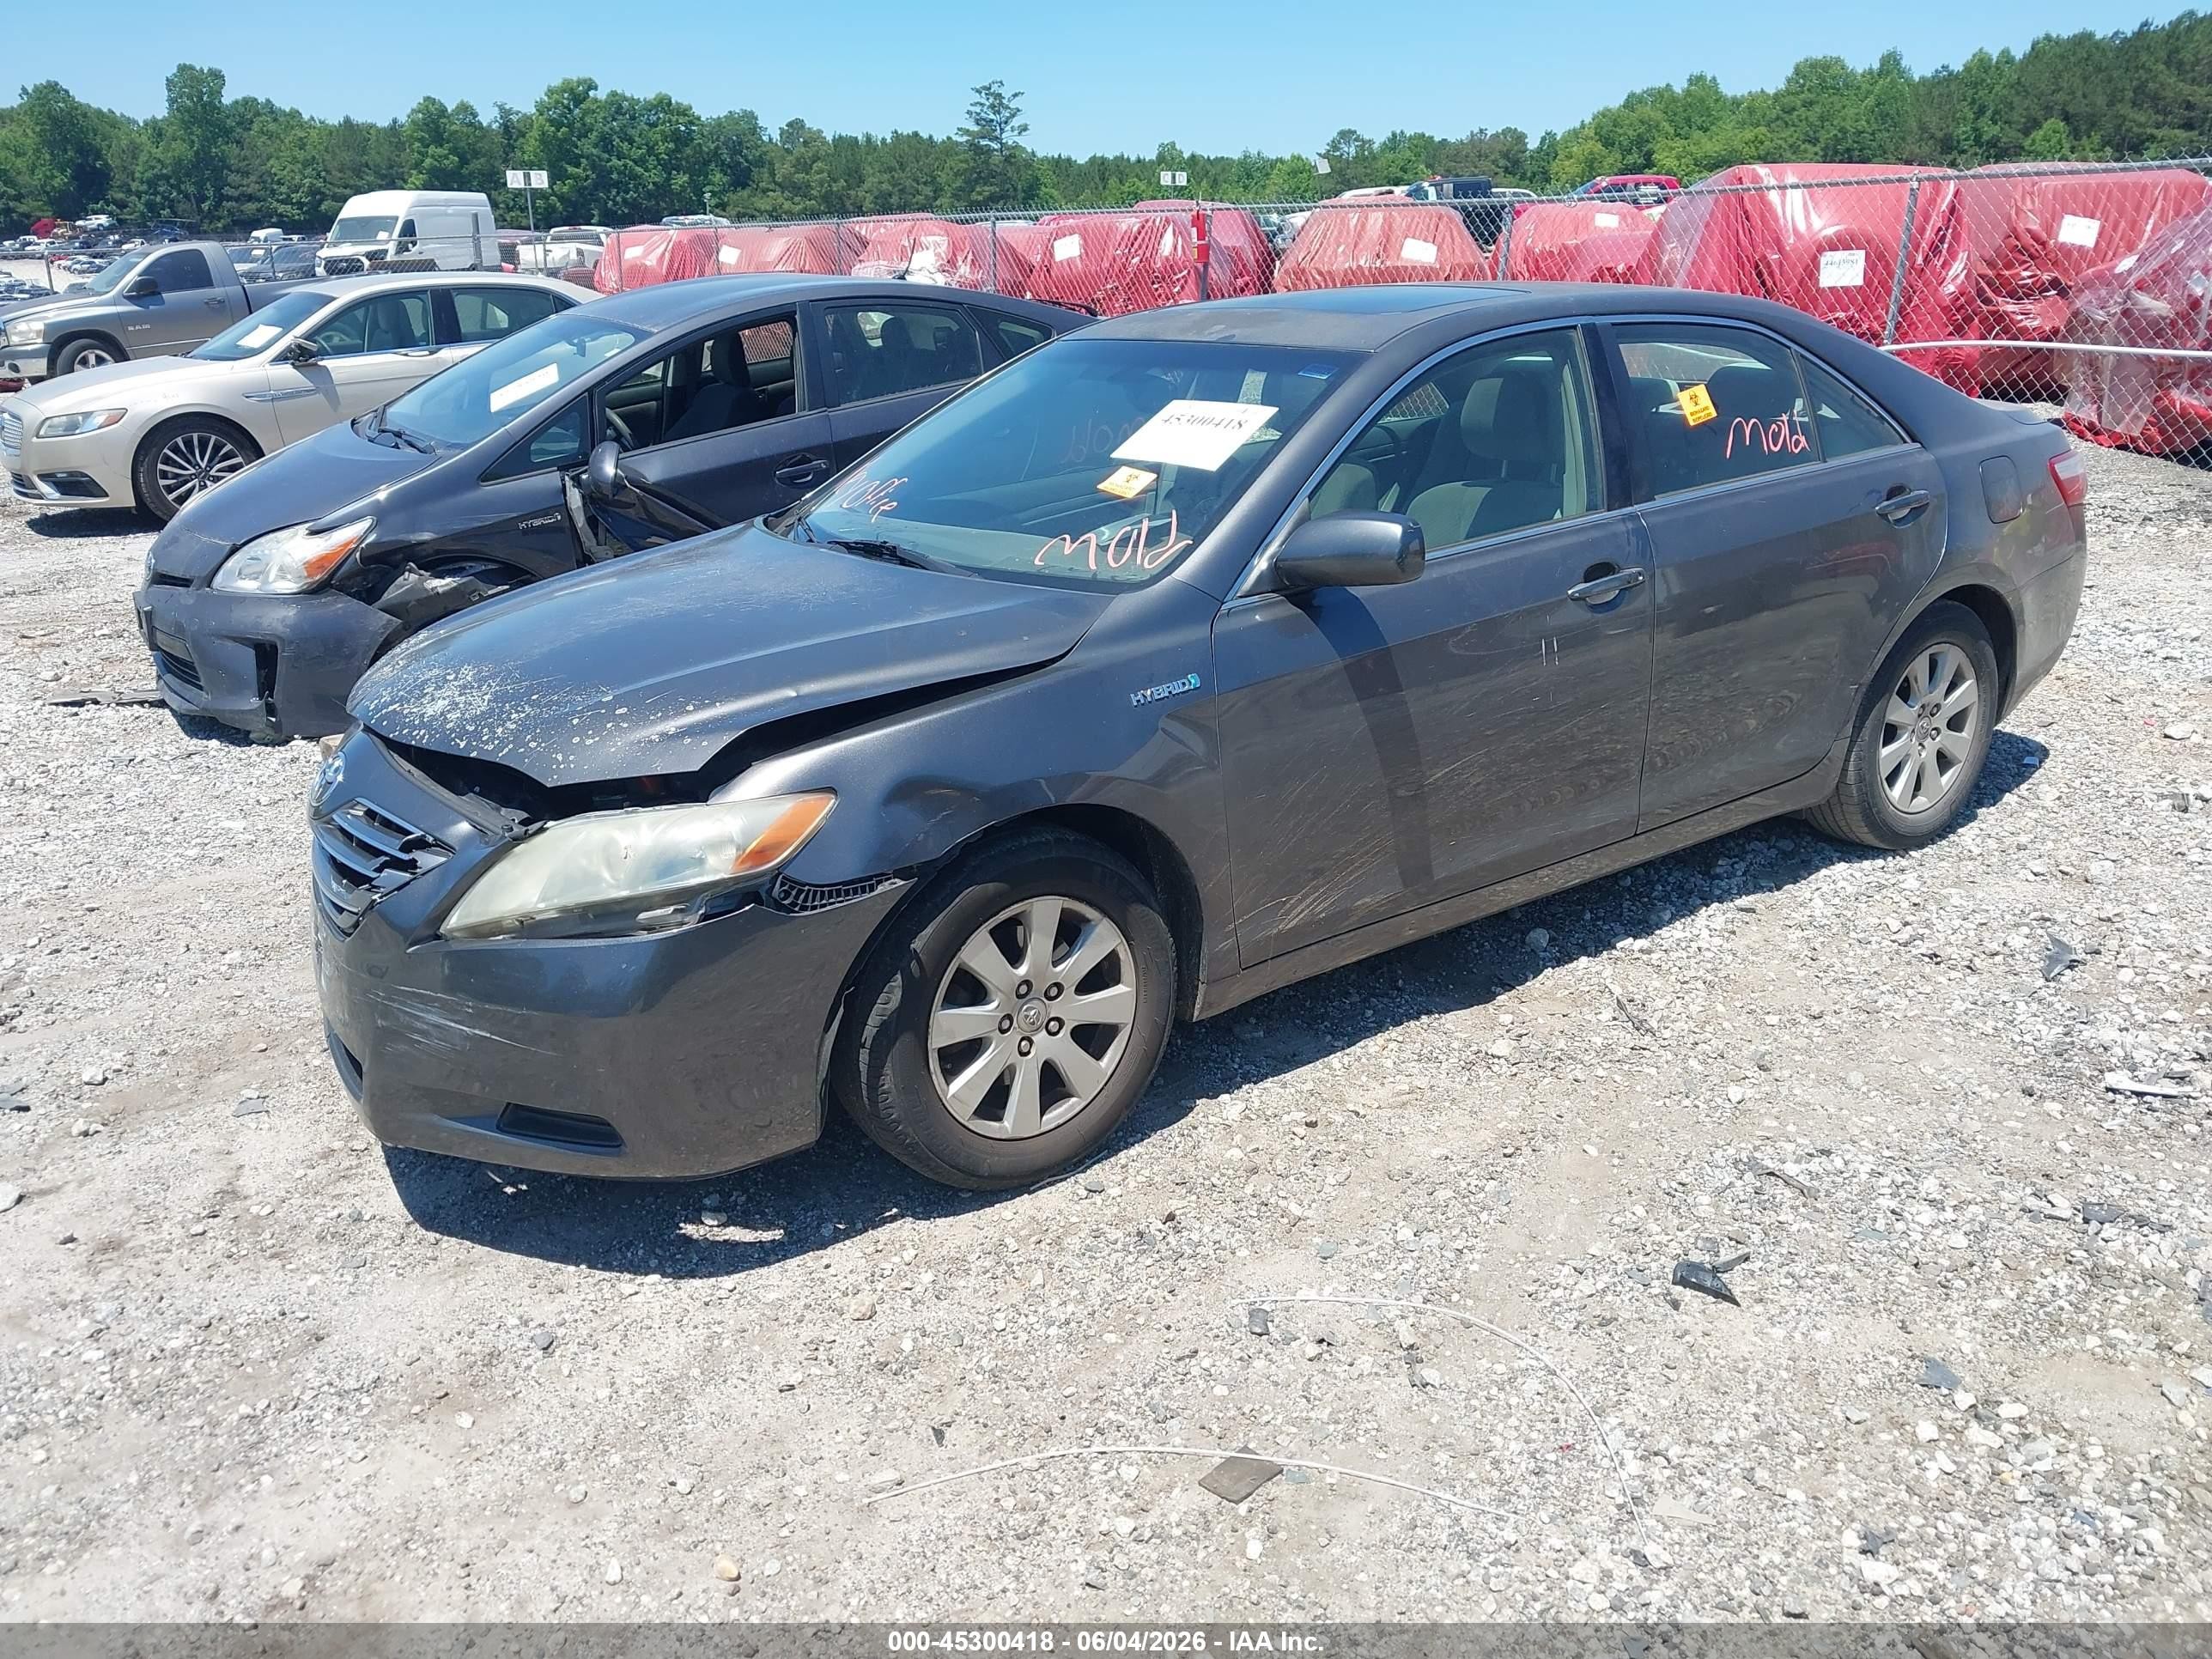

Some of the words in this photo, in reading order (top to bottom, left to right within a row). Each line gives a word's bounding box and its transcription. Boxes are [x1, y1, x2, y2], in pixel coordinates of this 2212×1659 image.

[509, 173, 522, 186] A
[534, 173, 544, 185] B
[1177, 173, 1186, 184] D
[1161, 412, 1249, 430] 45300418
[518, 515, 557, 530] HYBRID
[1129, 678, 1190, 708] HYBRID
